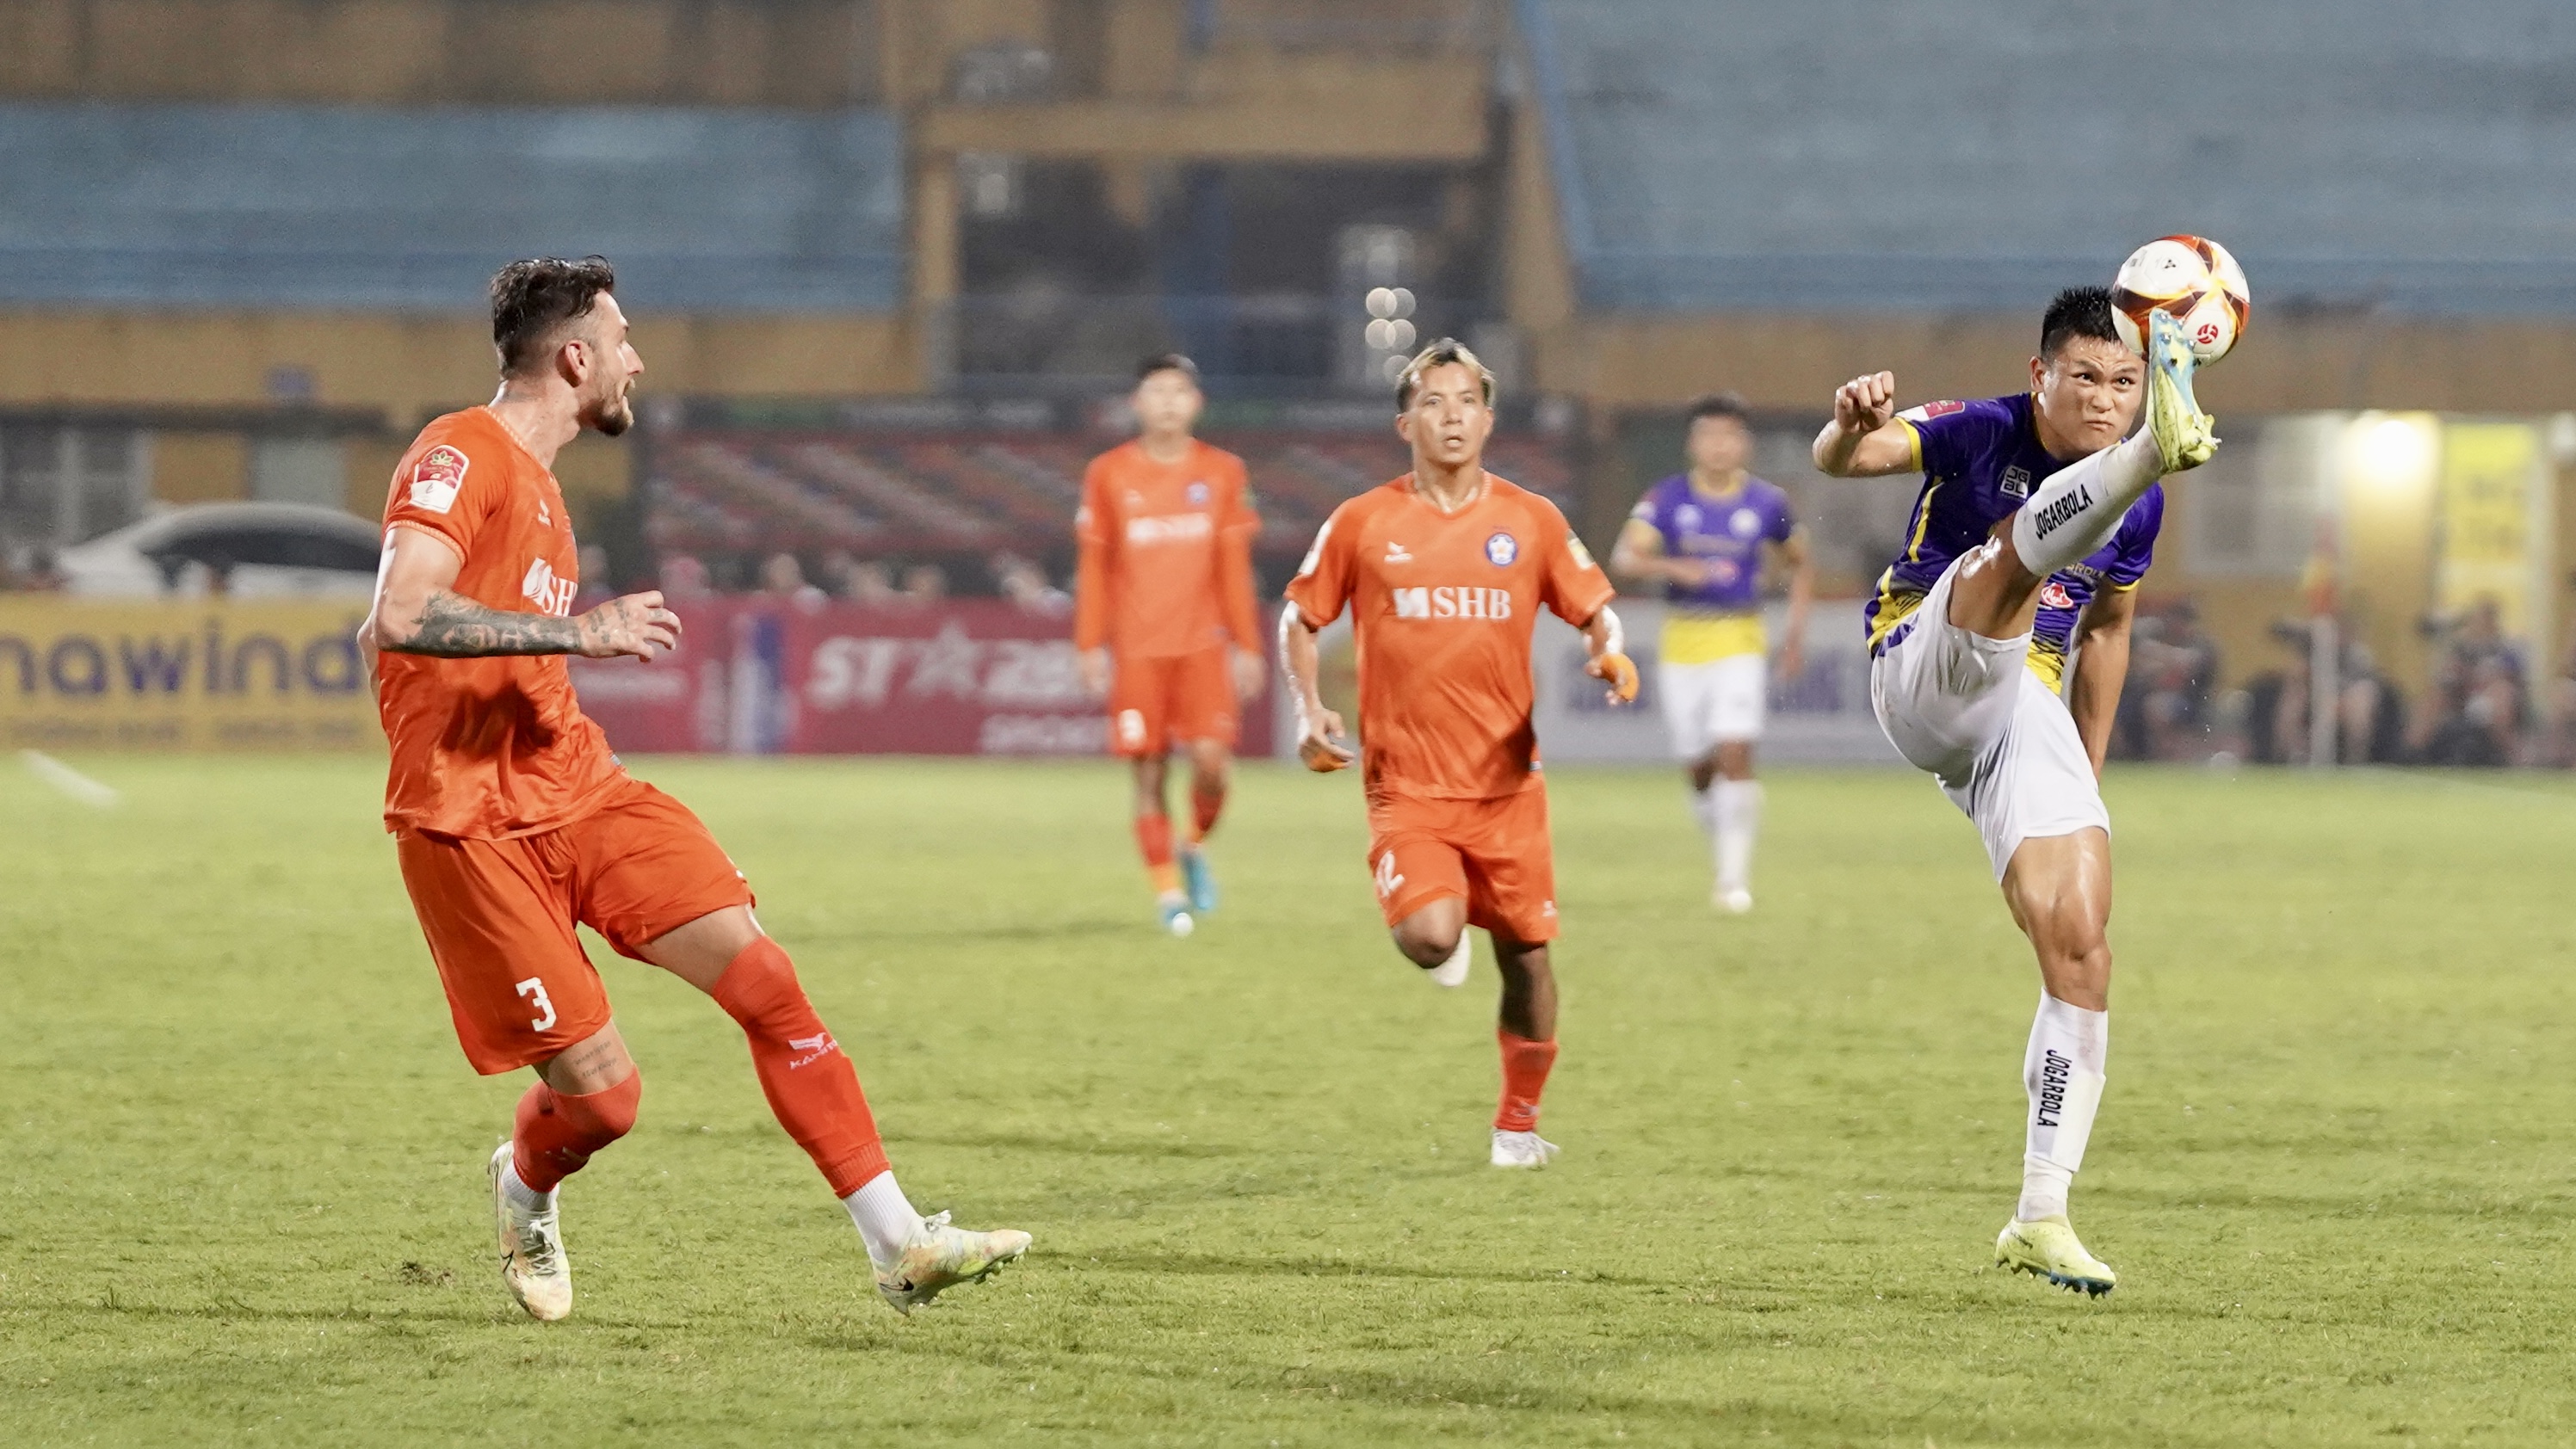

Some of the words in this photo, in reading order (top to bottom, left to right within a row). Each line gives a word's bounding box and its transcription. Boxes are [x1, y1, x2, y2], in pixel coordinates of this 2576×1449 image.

[2034, 484, 2093, 540] JOGARBOLA
[542, 574, 578, 617] SH
[1432, 586, 1511, 620] SHB
[516, 977, 557, 1032] 3
[2037, 1049, 2073, 1127] JOGARBOLA
